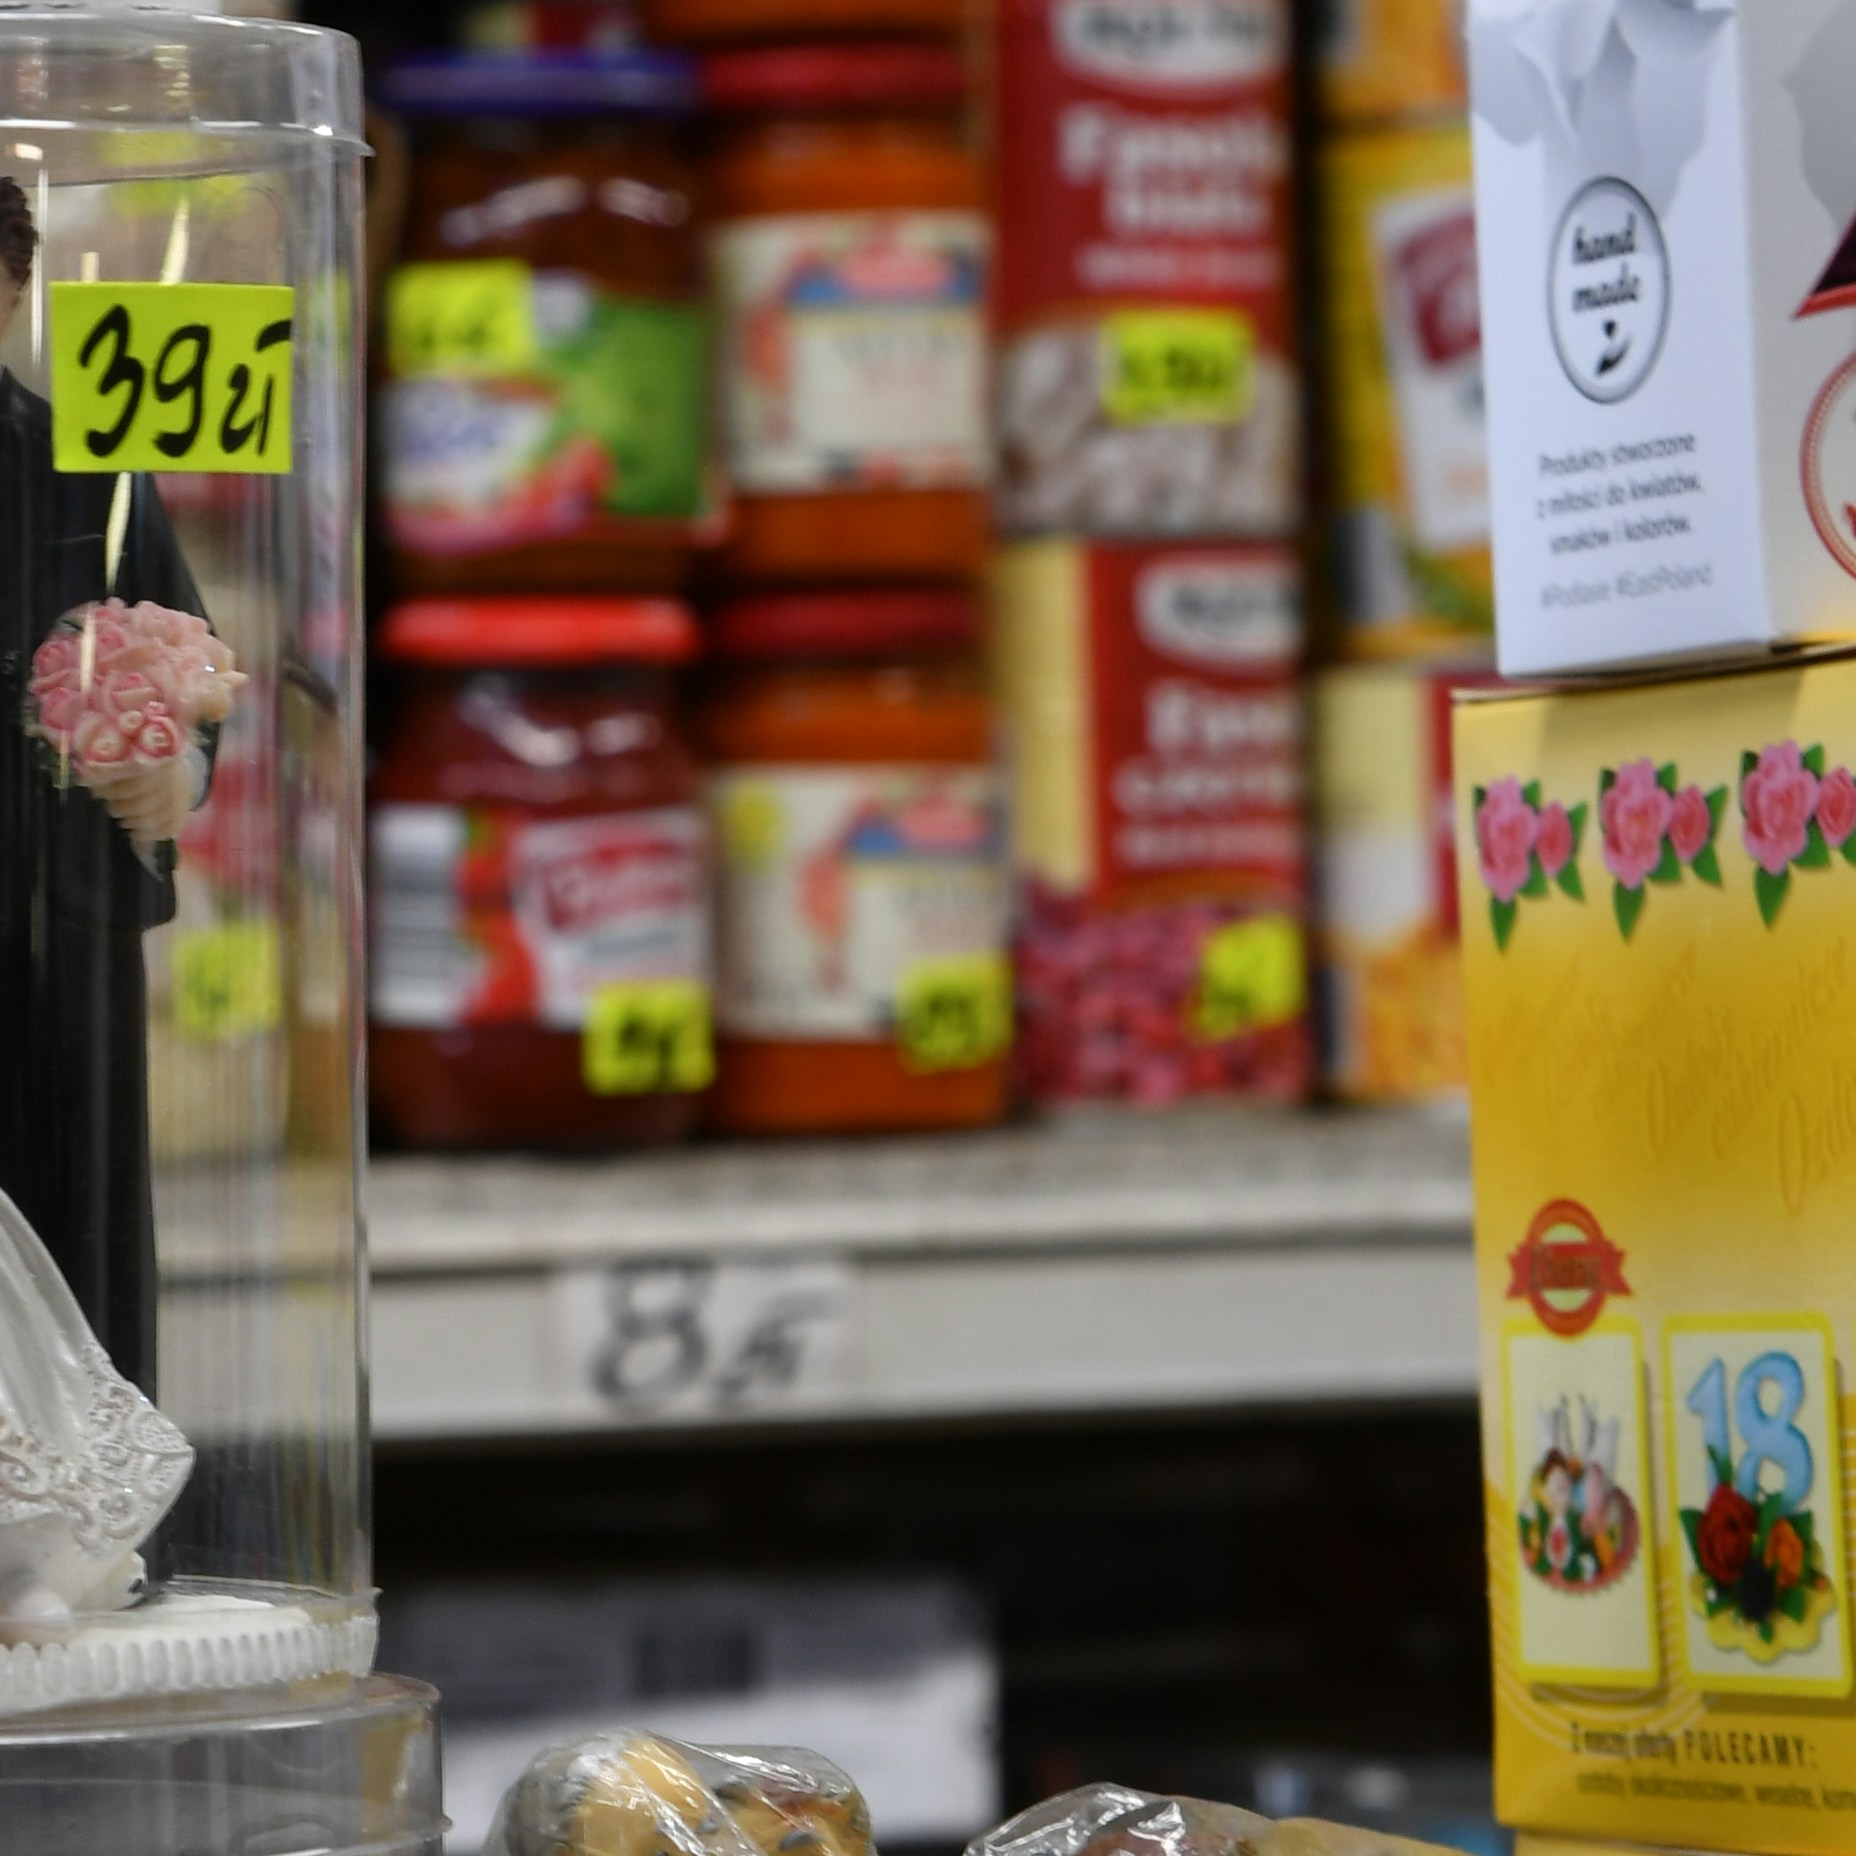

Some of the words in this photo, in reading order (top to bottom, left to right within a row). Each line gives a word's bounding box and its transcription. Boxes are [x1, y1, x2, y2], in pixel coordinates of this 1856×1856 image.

[1571, 212, 1636, 266] hand
[1571, 262, 1640, 313] made
[1686, 1351, 1814, 1516] 18
